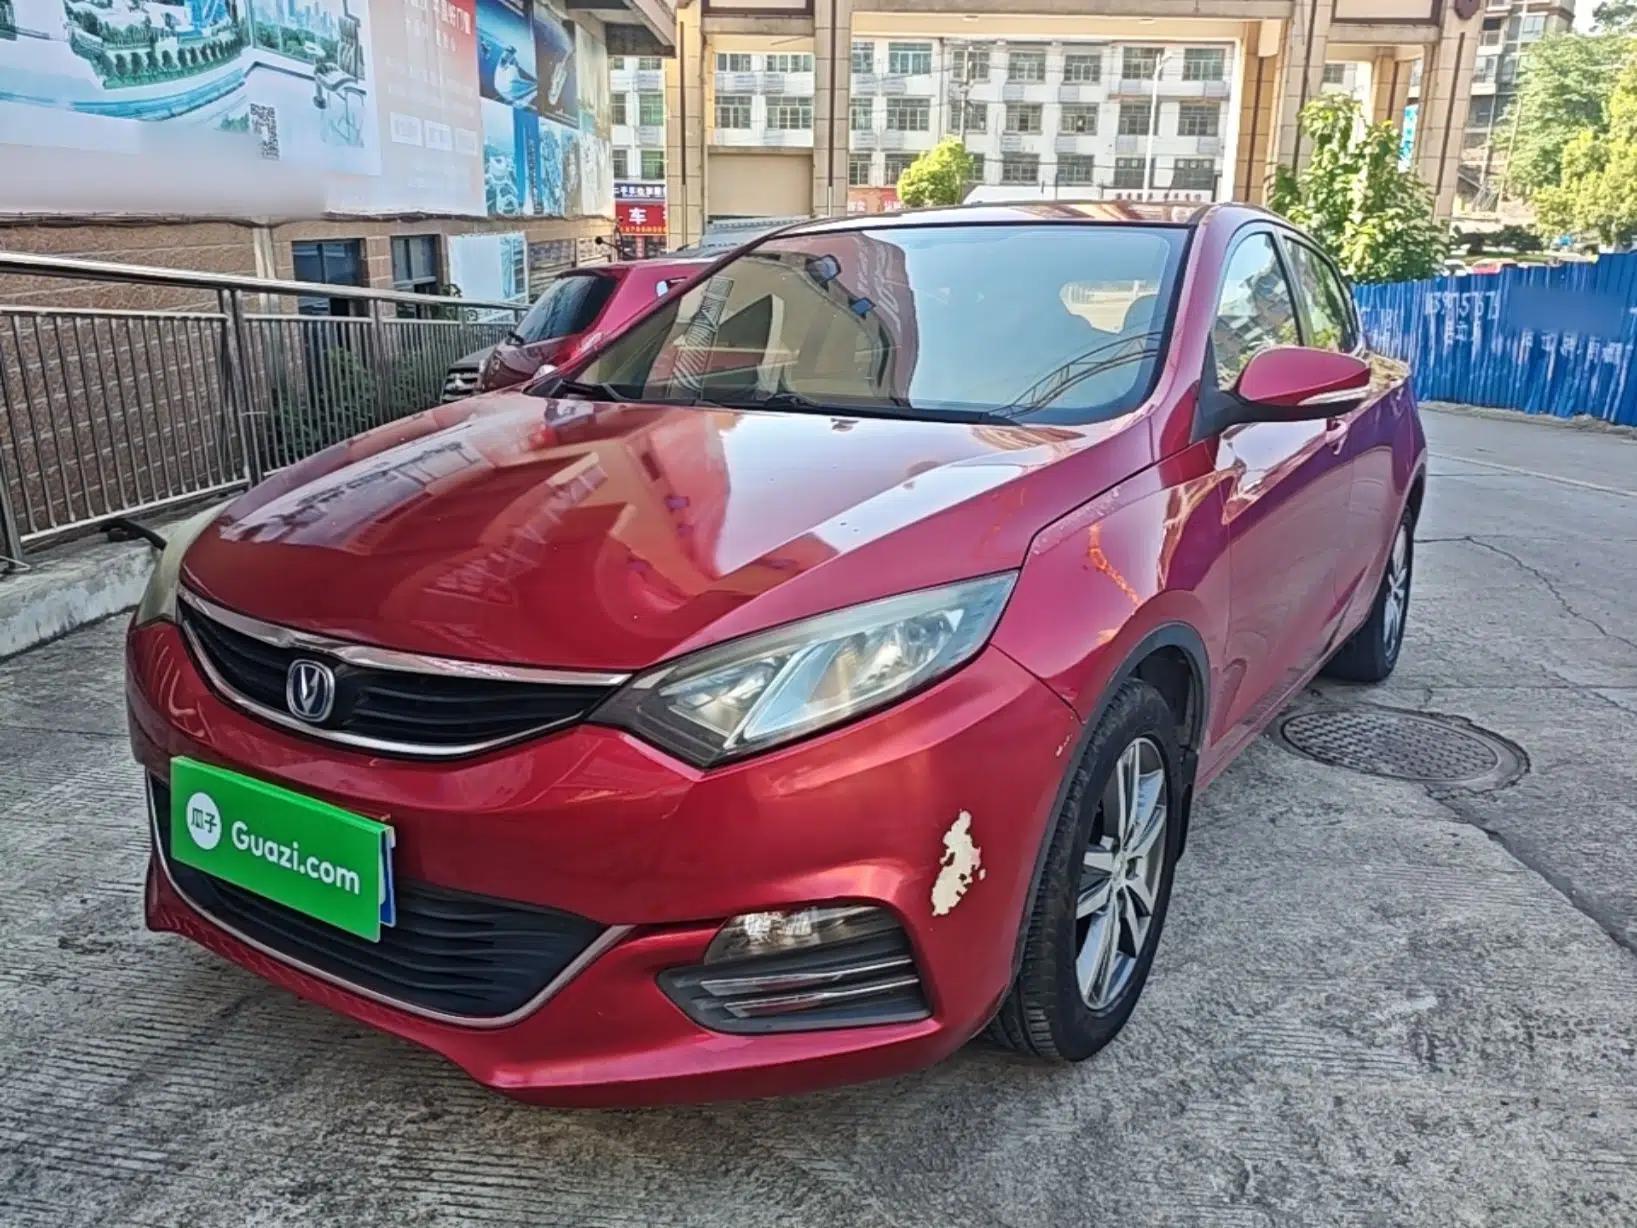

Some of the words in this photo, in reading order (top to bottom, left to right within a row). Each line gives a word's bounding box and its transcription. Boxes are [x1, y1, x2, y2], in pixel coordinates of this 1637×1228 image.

[629, 207, 648, 225] 车
[192, 809, 217, 833] 瓜子
[232, 822, 359, 894] Guazi.com
